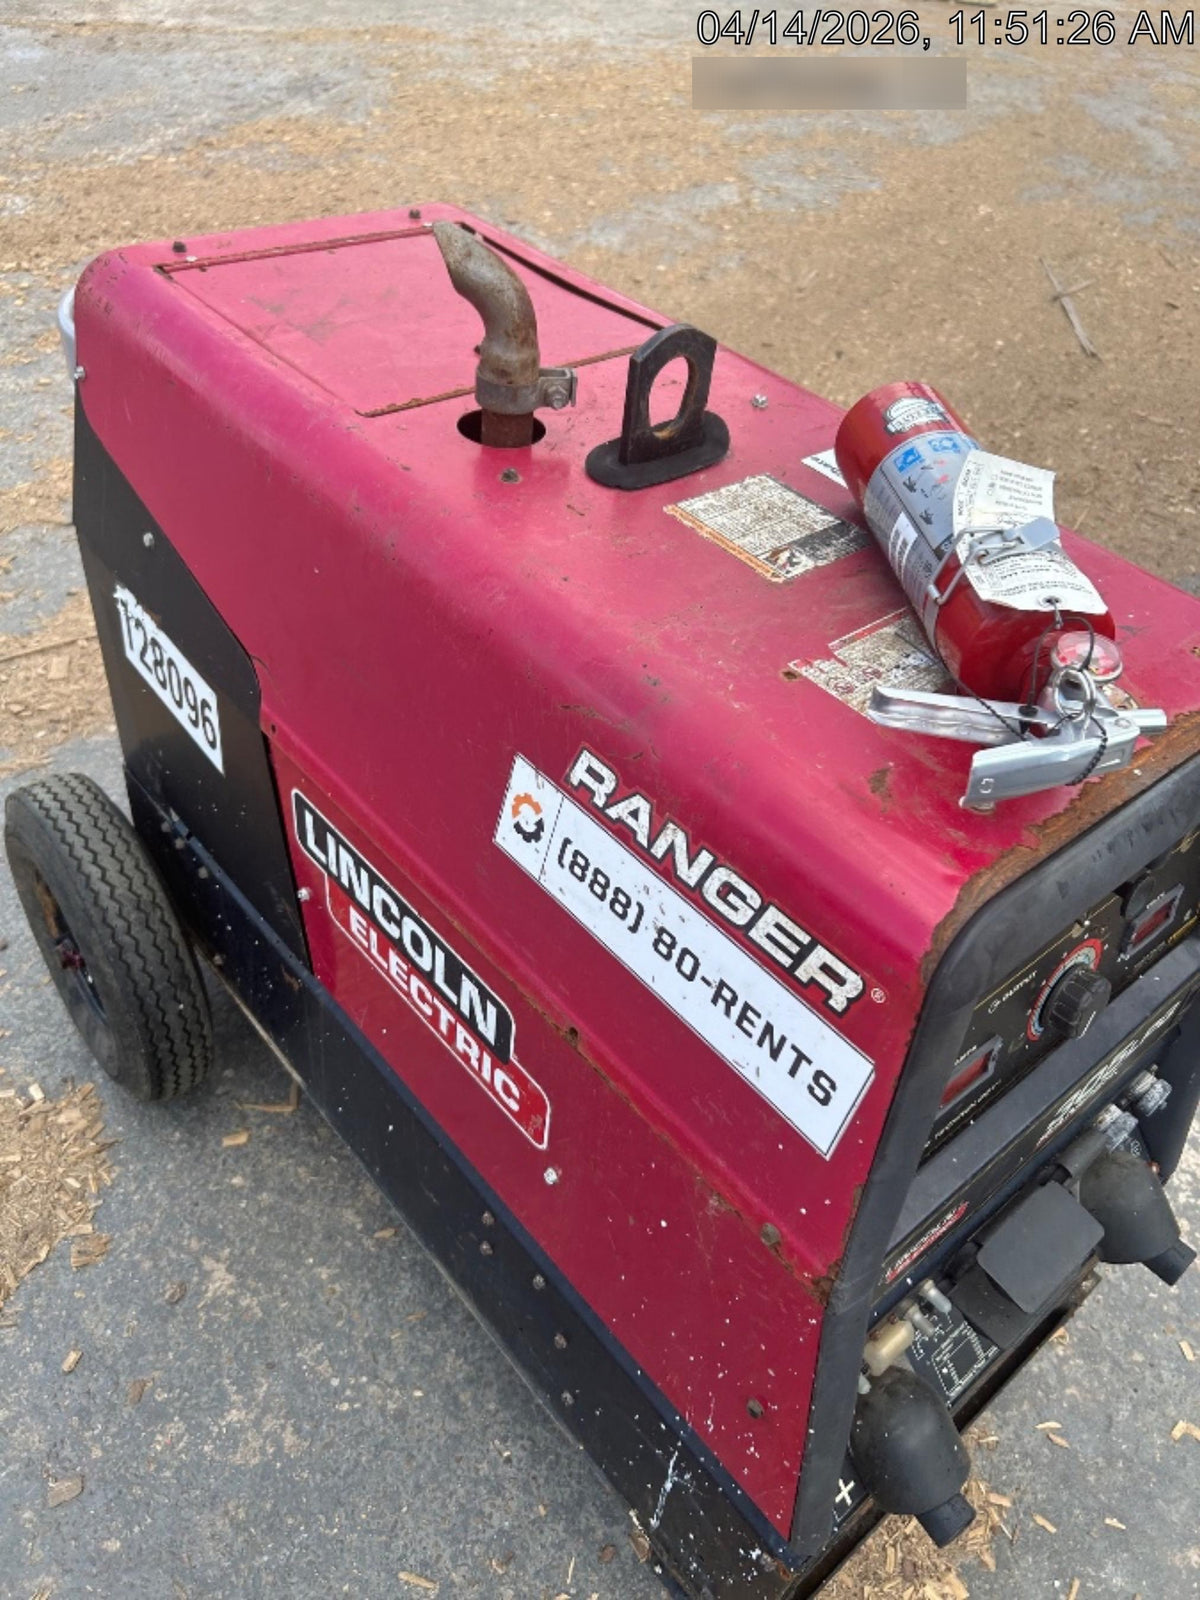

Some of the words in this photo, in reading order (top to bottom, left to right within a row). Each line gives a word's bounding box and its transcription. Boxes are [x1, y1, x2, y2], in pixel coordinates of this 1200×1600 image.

[304, 808, 499, 1046] LINCOLN
[349, 904, 521, 1113] ELECTRIC
[557, 836, 645, 934] (888)
[651, 926, 838, 1107] 80-RENTS
